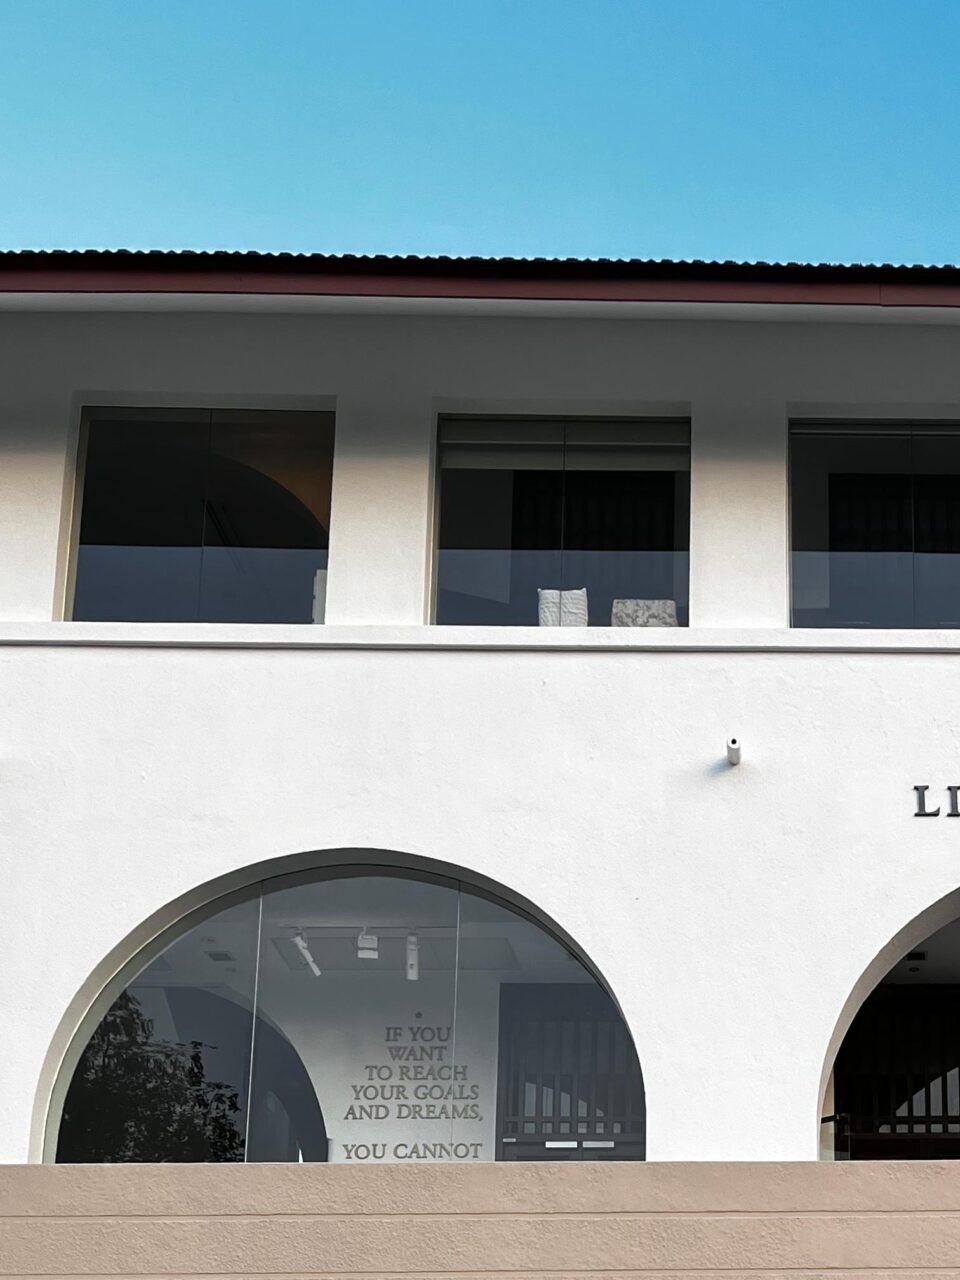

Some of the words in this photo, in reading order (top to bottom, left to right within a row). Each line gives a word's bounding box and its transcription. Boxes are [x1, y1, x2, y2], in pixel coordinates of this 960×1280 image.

[385, 1027, 402, 1042] IF
[408, 1027, 451, 1042] YOU
[387, 1046, 447, 1061] WANT
[365, 1065, 393, 1081] TO
[399, 1065, 468, 1081] REACH
[352, 1085, 408, 1100] YOUR
[414, 1085, 479, 1100] GOALS
[344, 1105, 389, 1120] AND
[396, 1104, 483, 1121] DREAMS,
[342, 1144, 386, 1160] YOU
[393, 1143, 483, 1159] CANNOT
